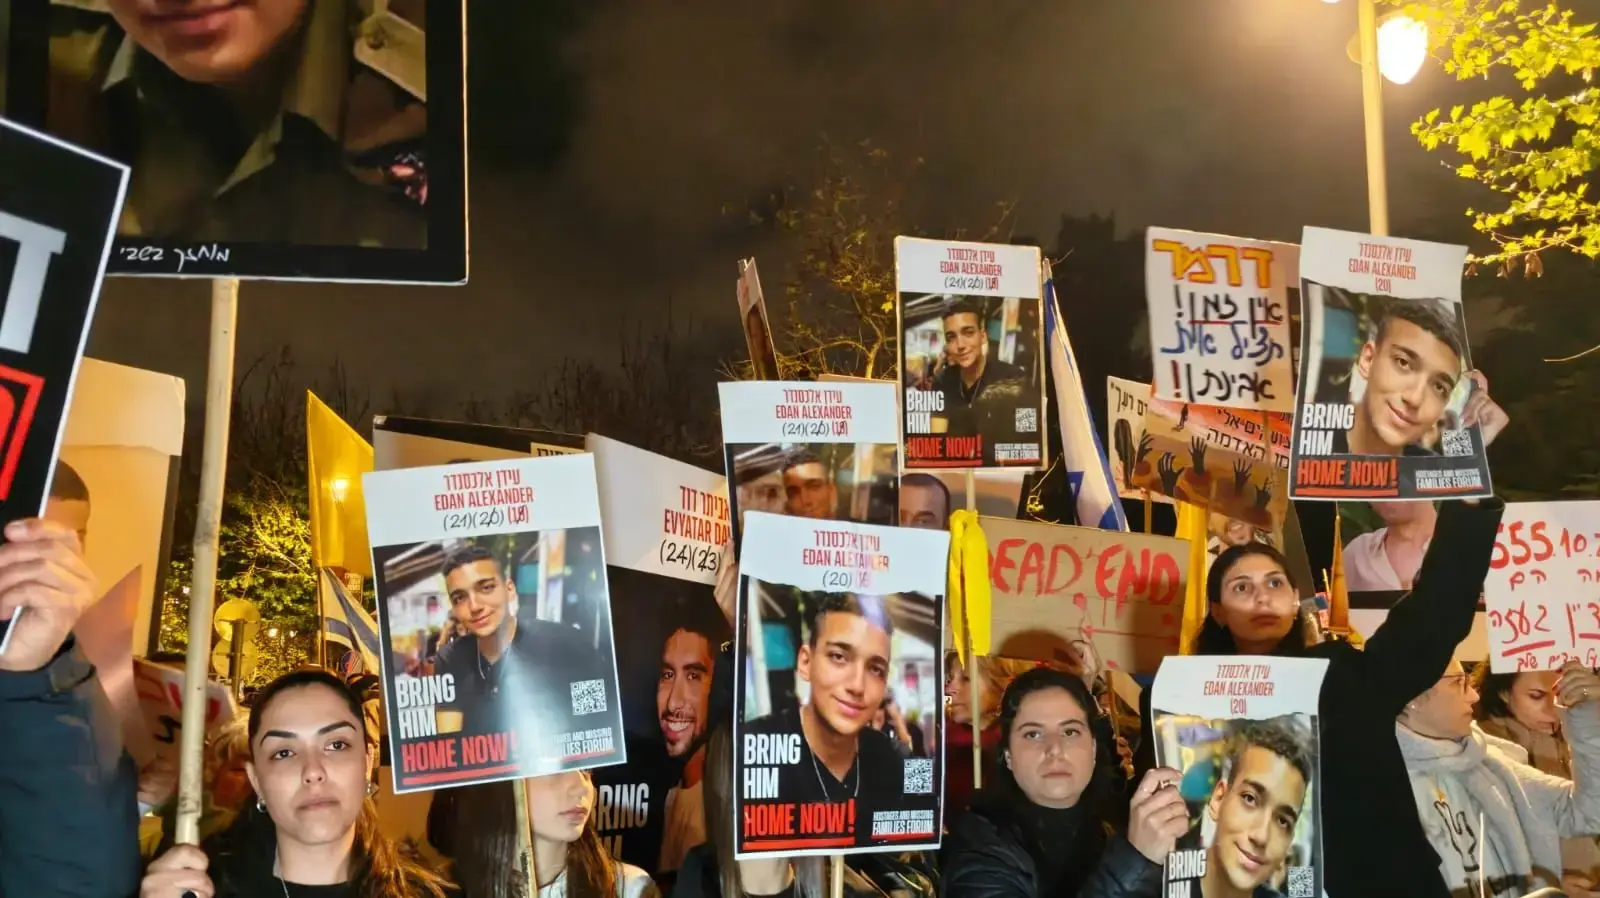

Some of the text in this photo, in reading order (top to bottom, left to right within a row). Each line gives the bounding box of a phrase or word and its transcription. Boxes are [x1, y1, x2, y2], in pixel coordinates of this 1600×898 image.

[120, 246, 164, 261] בשבי
[980, 250, 995, 263] עידן
[1152, 239, 1274, 289] דרמר
[1395, 248, 1412, 262] עידן
[940, 261, 1002, 276] EDAN ALEXANDER
[1349, 258, 1417, 280] EDAN ALEXANDER
[1375, 278, 1392, 293] (20)
[1248, 297, 1283, 339] אין
[1231, 320, 1285, 367] תציל
[823, 390, 843, 404] עידן
[906, 390, 945, 412] BRING
[775, 405, 852, 420] EDAN ALEXANDER
[907, 411, 931, 434] HIM
[1302, 403, 1355, 430] BRING
[907, 436, 943, 459] HOME
[1206, 427, 1266, 461] האדמה
[1299, 430, 1334, 455] HIM
[443, 469, 521, 491] עידן אלכסנדר
[1297, 458, 1398, 487] HOME NOW!
[434, 487, 534, 511] EDAN ALEXANDER
[680, 485, 697, 513] דוד
[664, 508, 712, 544] EVYATAR
[803, 548, 890, 571] EDAN ALEAER
[822, 570, 853, 588] (20)
[988, 538, 1181, 616] EAD END
[1508, 569, 1547, 592] הם
[1488, 600, 1551, 645] בעזה
[1252, 665, 1271, 680] עידן
[394, 674, 456, 708] BRING
[1203, 681, 1275, 696] EDAN ALEXANDER
[1230, 698, 1247, 715] (20)
[399, 707, 437, 739] HIM
[402, 738, 458, 773] HOME
[743, 733, 801, 765] BRING
[743, 767, 780, 799] HIM
[590, 782, 650, 831] RING
[744, 798, 856, 837] HOME NOW!
[1168, 849, 1207, 880] BRING
[1168, 879, 1191, 898] HIM
